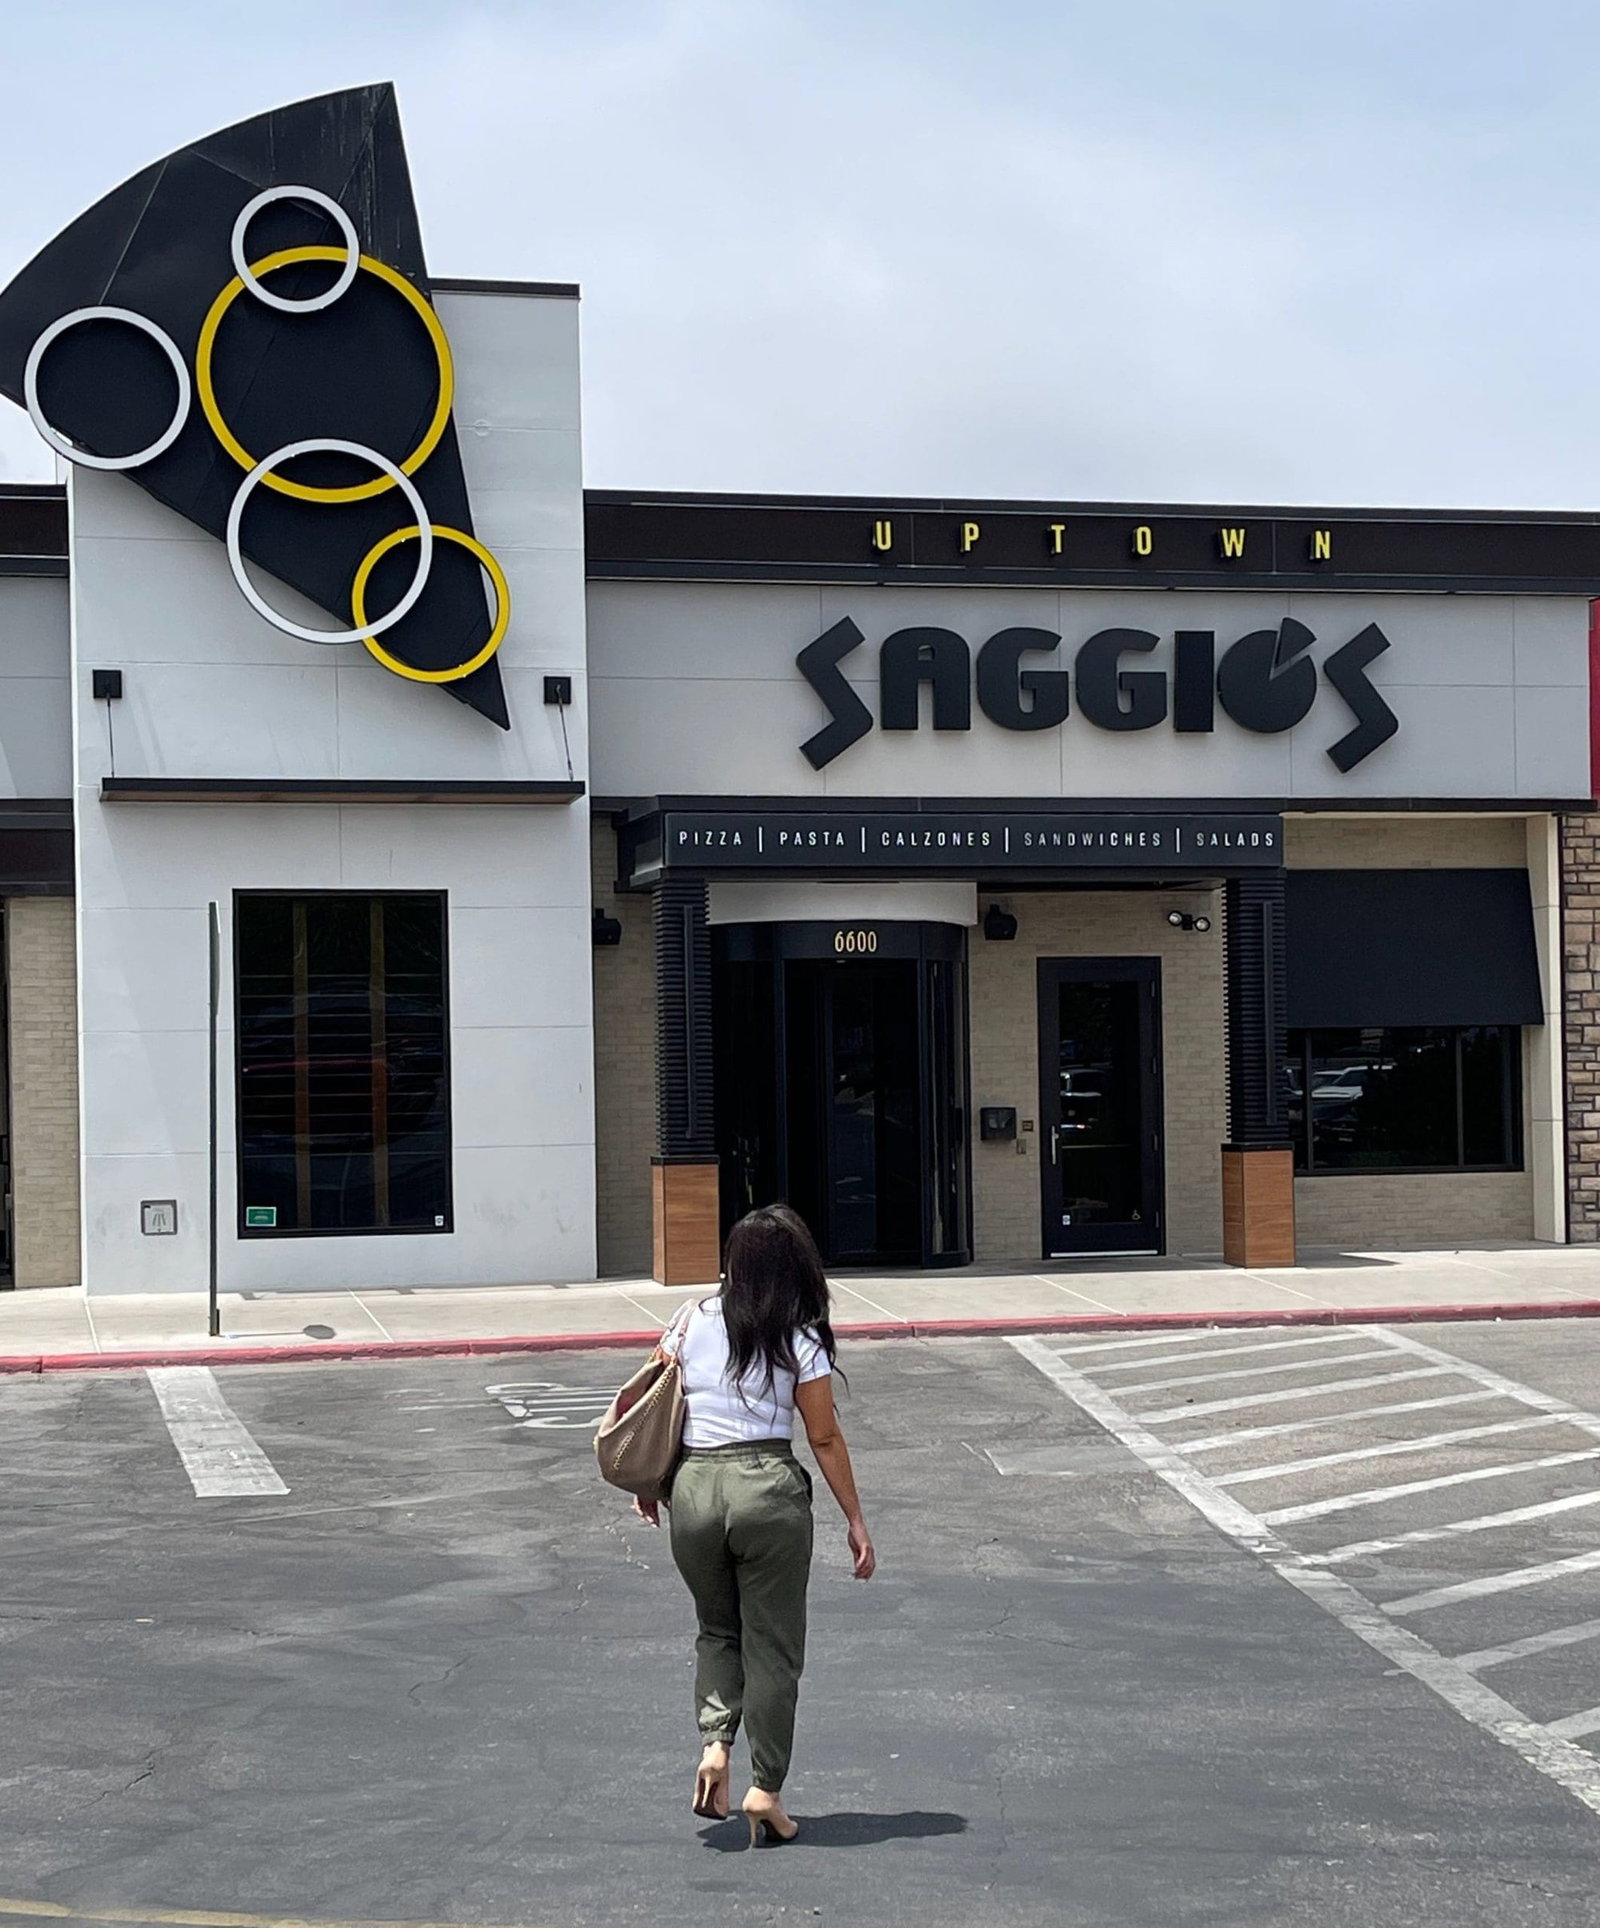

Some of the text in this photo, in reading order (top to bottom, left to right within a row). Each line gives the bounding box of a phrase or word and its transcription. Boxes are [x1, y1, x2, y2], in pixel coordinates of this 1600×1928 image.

[875, 521, 1332, 560] UPTOWN
[679, 831, 1274, 848] PIZZA PASTA CALZONES SANDWICHES SALADS
[834, 930, 877, 954] 6600
